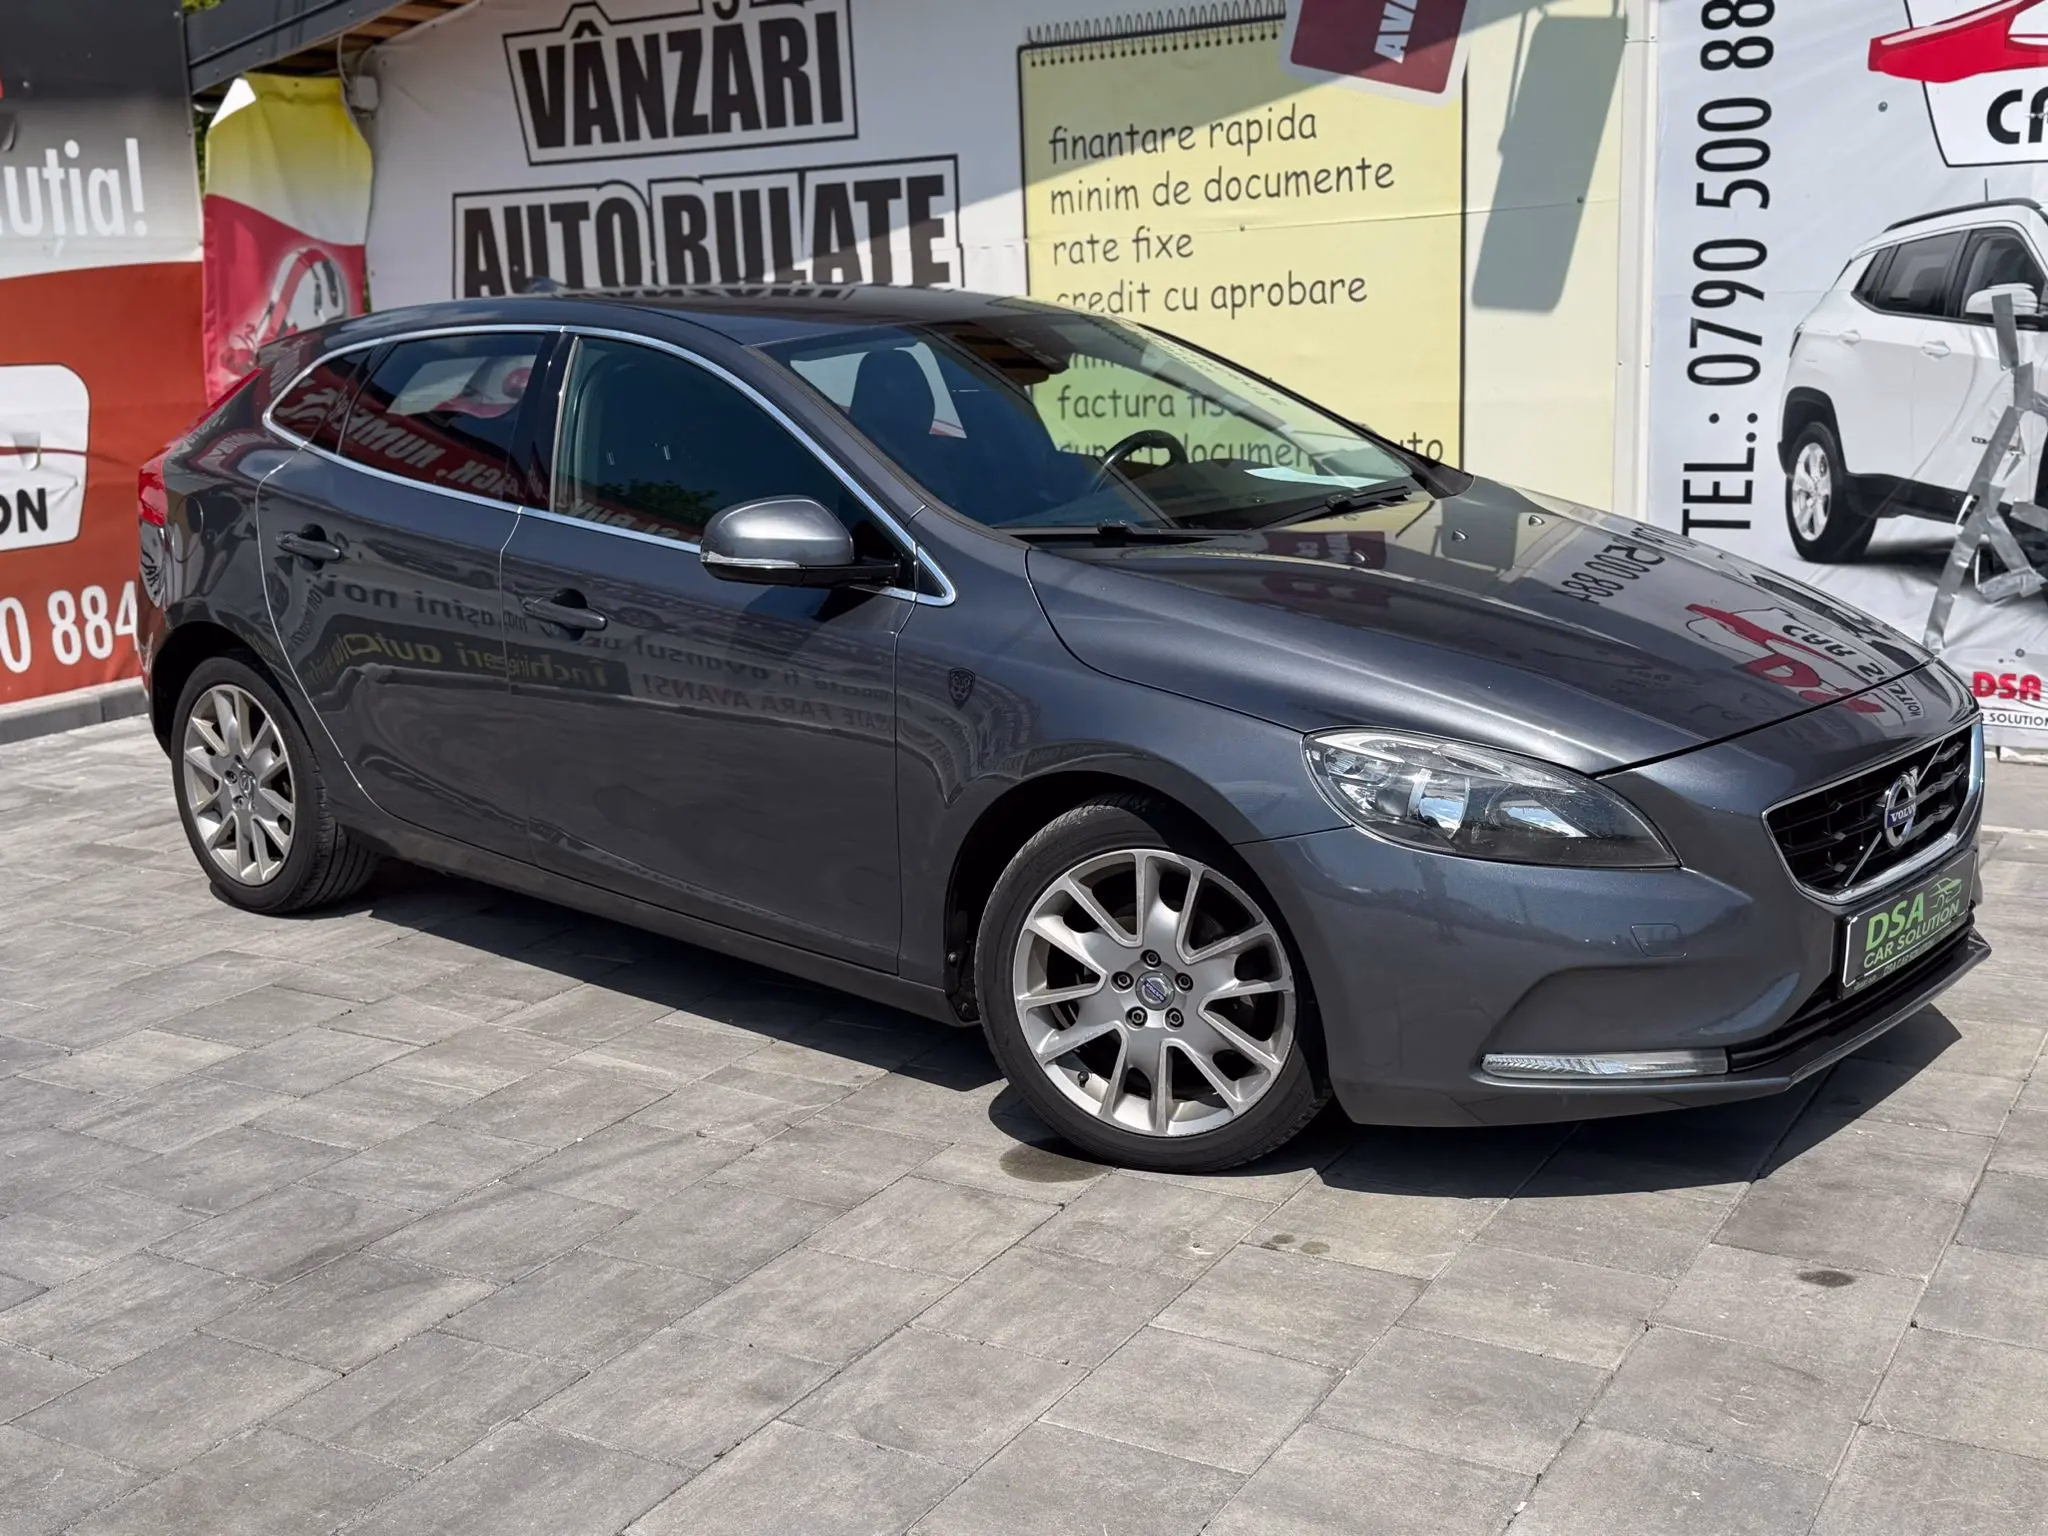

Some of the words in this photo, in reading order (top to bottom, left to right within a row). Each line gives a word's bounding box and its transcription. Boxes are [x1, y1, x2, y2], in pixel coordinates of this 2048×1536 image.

[518, 0, 843, 149] VÂNZĂRI
[1049, 122, 1197, 164] finantare
[1208, 103, 1318, 156] rapida
[1696, 97, 1773, 210] 500
[1050, 178, 1140, 215] minim
[1153, 170, 1192, 207] de
[1204, 157, 1396, 203] documente
[1053, 232, 1120, 266] rate
[1133, 226, 1195, 263] fixe
[1164, 284, 1198, 312] cu
[1210, 270, 1369, 320] aprobare
[1687, 237, 1768, 386] 0790
[1057, 384, 1175, 421] factura
[1682, 413, 1758, 536] TEL.:
[1973, 671, 2042, 702] DSA
[1863, 941, 1895, 969] CAR
[1897, 898, 1961, 951] SOLUTION
[1865, 892, 1925, 953] DSA
